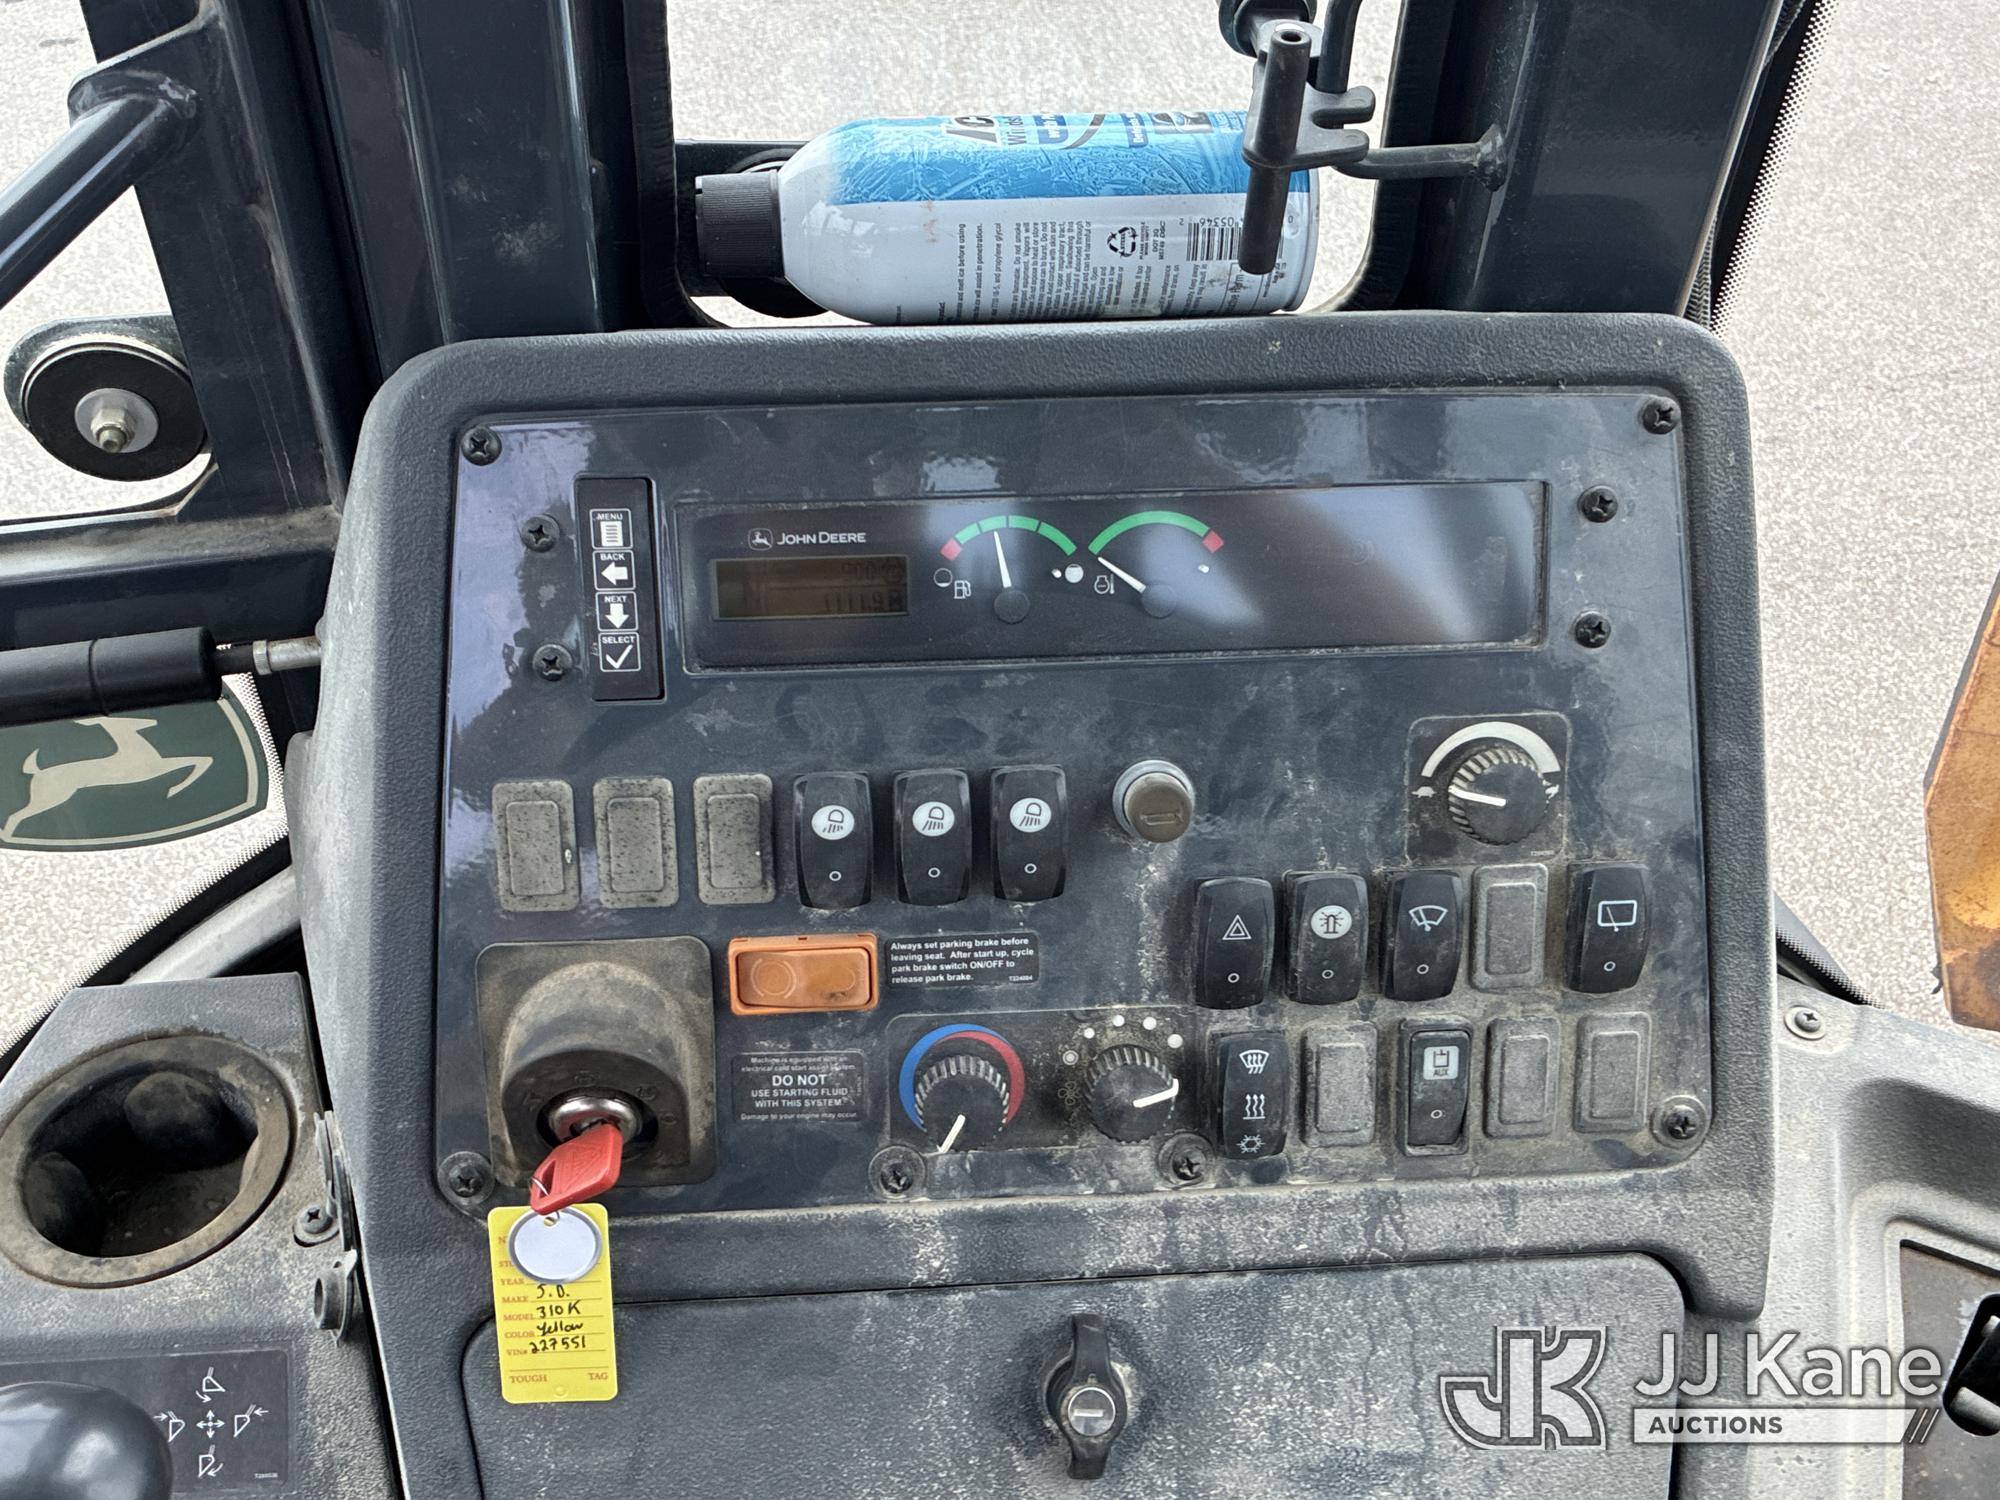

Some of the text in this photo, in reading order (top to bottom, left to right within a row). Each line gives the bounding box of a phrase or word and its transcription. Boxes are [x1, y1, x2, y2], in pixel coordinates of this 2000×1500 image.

[1199, 216, 1235, 227] 05346
[957, 224, 966, 244] using
[994, 223, 1003, 242] glycol
[1041, 233, 1048, 242] Do
[1075, 221, 1084, 245] through
[976, 224, 984, 264] penetration.
[957, 245, 965, 267] before
[994, 243, 1003, 272] propylene
[1040, 244, 1048, 260] burst.
[1057, 240, 1066, 272] respiratory
[1065, 236, 1075, 269] Swallowing
[1013, 257, 1021, 265] Do
[1074, 246, 1082, 273] absorbed
[957, 268, 965, 277] ice
[777, 531, 867, 546] JOHN DEERE
[600, 553, 626, 561] BACK
[602, 636, 635, 644] SELECT
[891, 938, 1029, 951] Always set parking brake before
[891, 953, 923, 962] leaving
[925, 952, 945, 960] seat.
[950, 951, 972, 959] After
[973, 950, 993, 958] start
[1011, 948, 1034, 958] cycle
[891, 960, 1015, 974] park brake switch ON/OFF to
[892, 975, 924, 984] release
[925, 975, 944, 984] park
[946, 973, 974, 981] brake.
[1433, 1068, 1449, 1078] AUX
[772, 1074, 827, 1086] DO NOT
[751, 1088, 848, 1098] USE STARTING FLUID
[755, 1100, 780, 1108] WITH
[782, 1099, 802, 1107] THIS
[822, 1112, 836, 1120] may
[500, 1278, 524, 1286] YEAR
[502, 1296, 529, 1304] MAKE
[504, 1331, 535, 1339] COLOR
[529, 1335, 586, 1354] 227551
[506, 1348, 528, 1356] VIN#
[509, 1372, 609, 1384] TOUGH TAG
